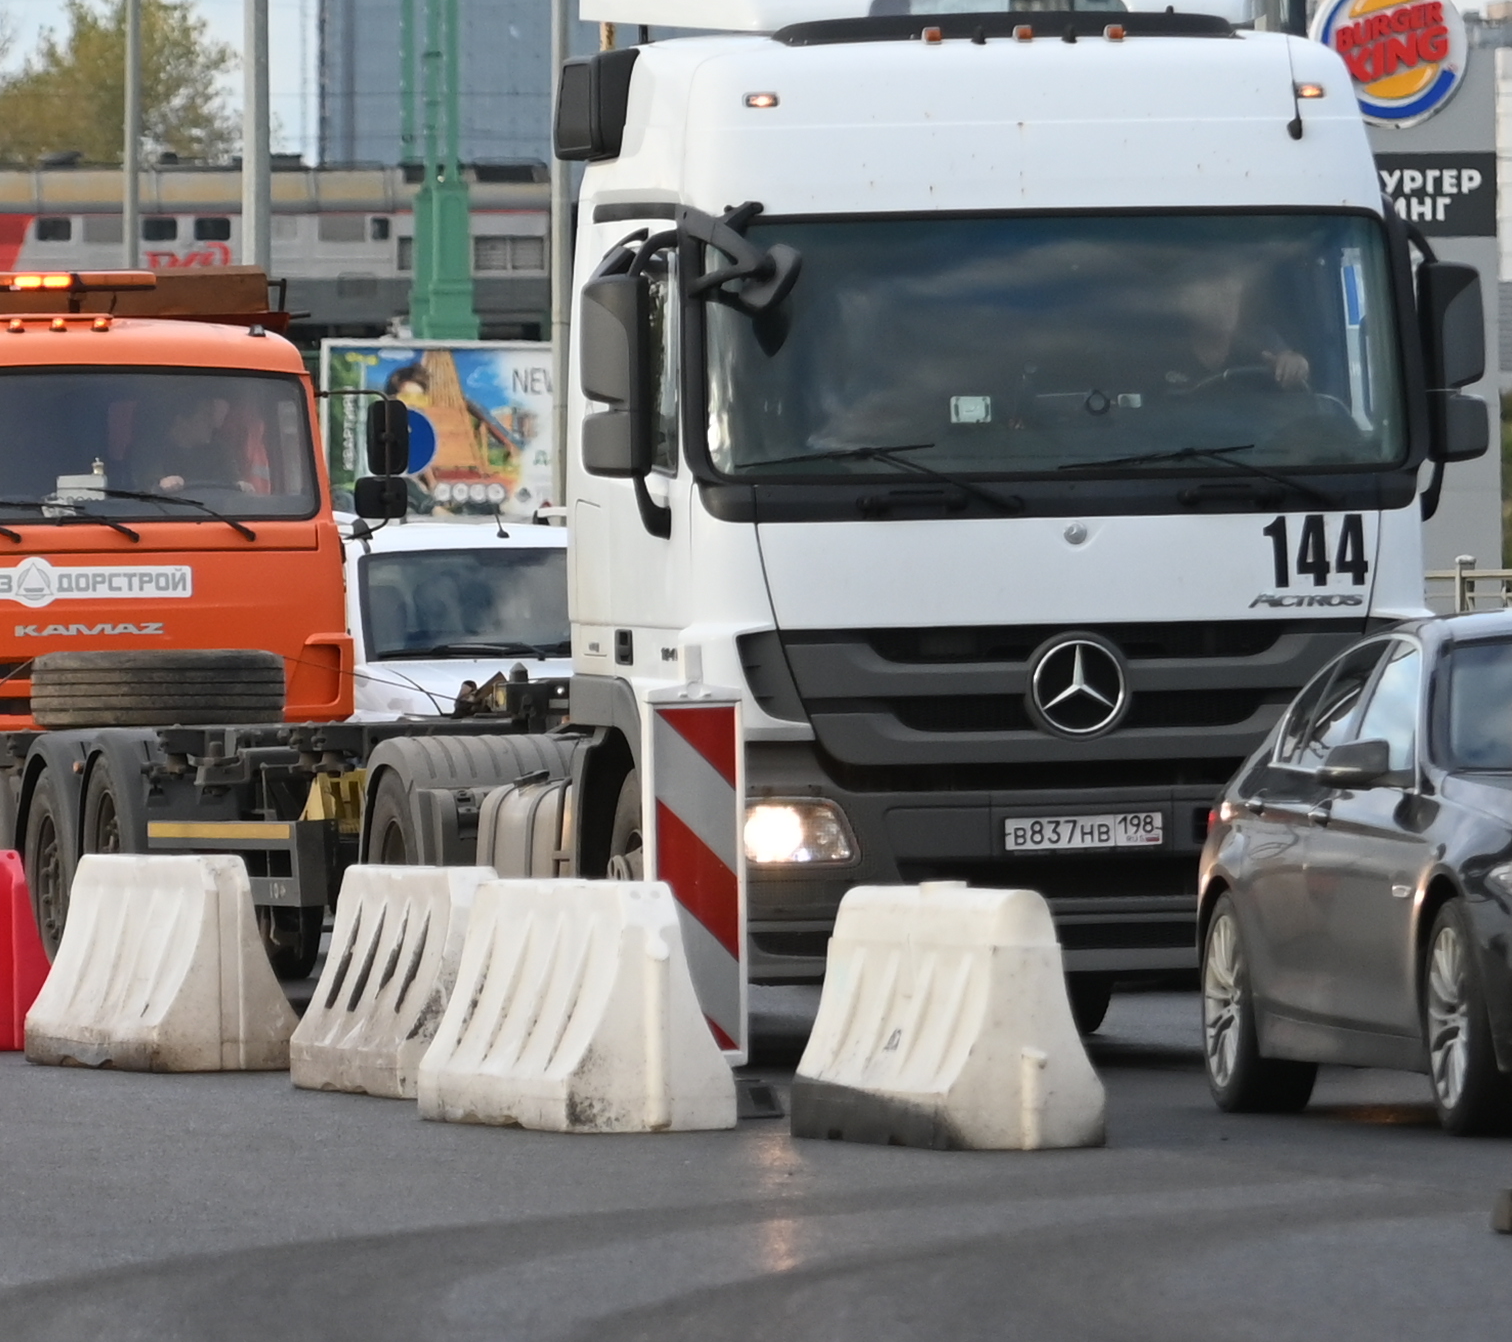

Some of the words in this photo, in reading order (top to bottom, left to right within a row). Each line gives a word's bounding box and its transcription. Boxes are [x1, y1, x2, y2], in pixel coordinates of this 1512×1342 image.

[1335, 0, 1444, 53] BURGER
[1342, 24, 1449, 83] KING
[1380, 167, 1483, 195] УРГЕР
[1393, 195, 1453, 222] ИНГ
[1263, 514, 1369, 589] 144
[57, 568, 187, 593] ДОРСТРОЙ
[14, 622, 165, 637] KAMAZ
[1013, 819, 1111, 847] В837НВ
[1117, 814, 1155, 835] 198
